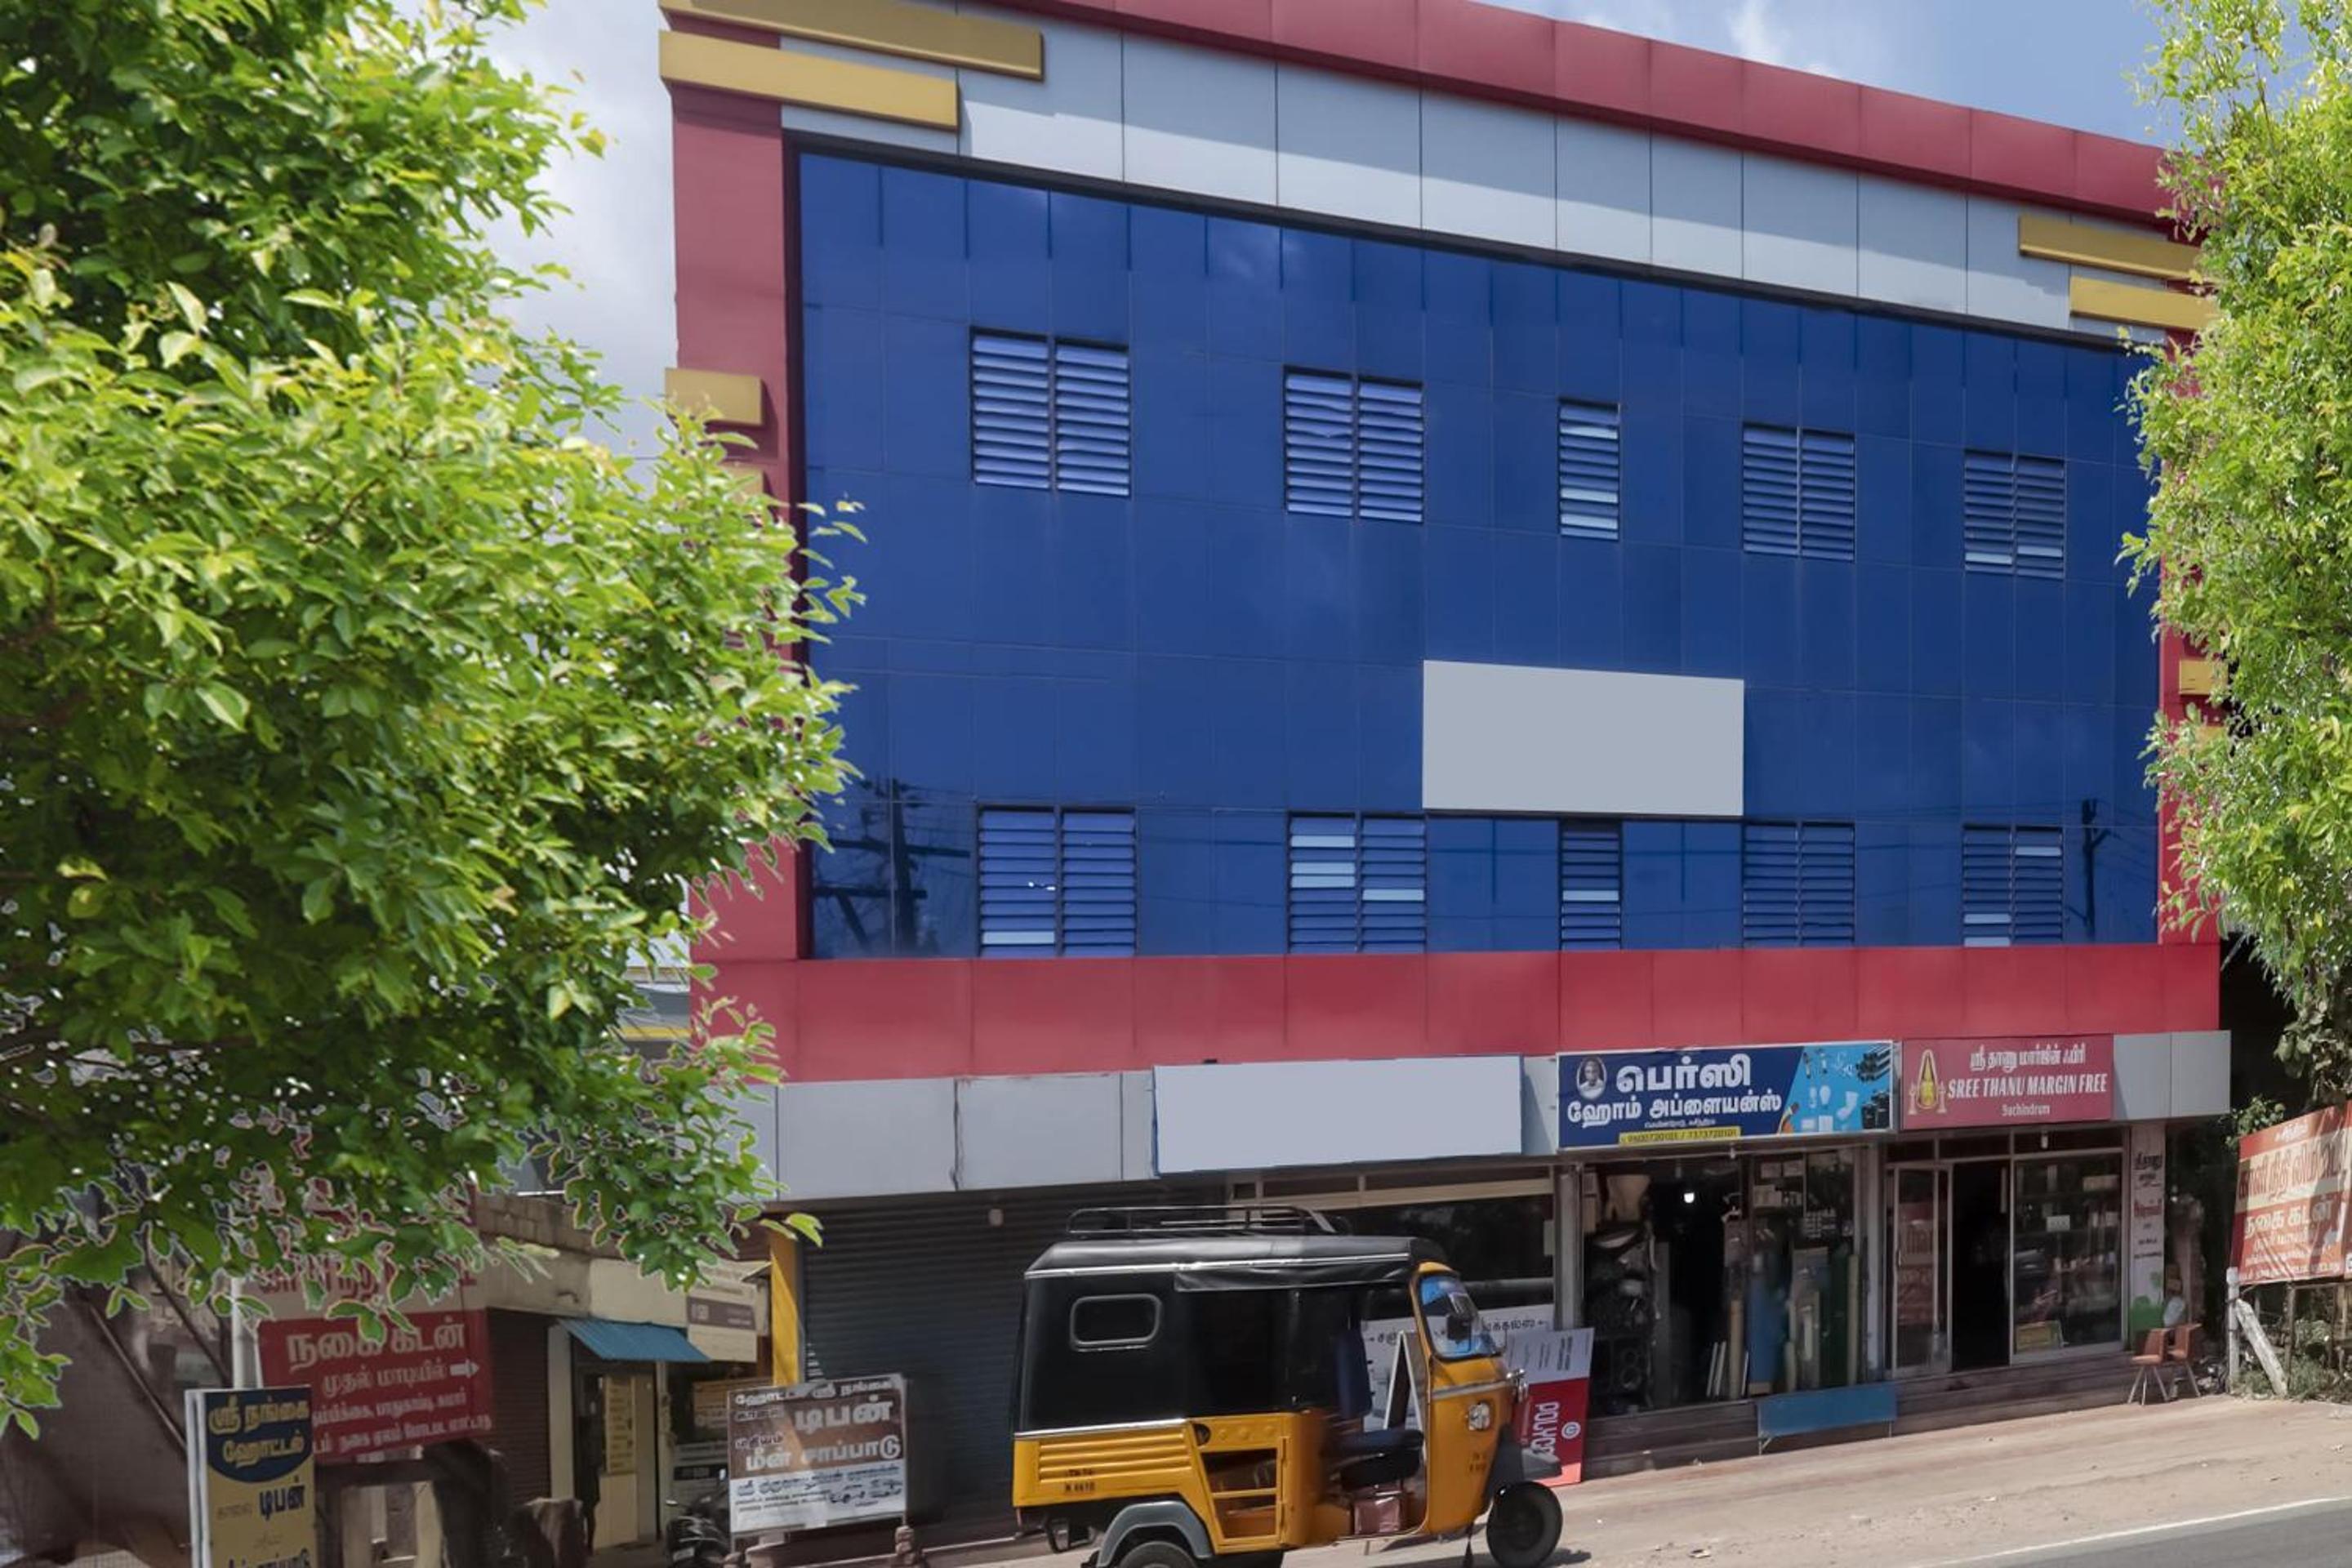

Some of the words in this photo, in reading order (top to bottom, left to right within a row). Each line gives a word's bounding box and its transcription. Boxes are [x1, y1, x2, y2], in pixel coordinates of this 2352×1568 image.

[1615, 1053, 1751, 1094] பெர்ஸி
[1947, 1078, 1980, 1098] SREE
[1983, 1076, 2025, 1098] THANU
[2026, 1074, 2078, 1097] MARGIN
[2078, 1073, 2108, 1094] FREE
[1567, 1095, 1642, 1129] ஹோம்
[794, 1394, 893, 1435] டிபன்
[1530, 1401, 1561, 1457] POLYC
